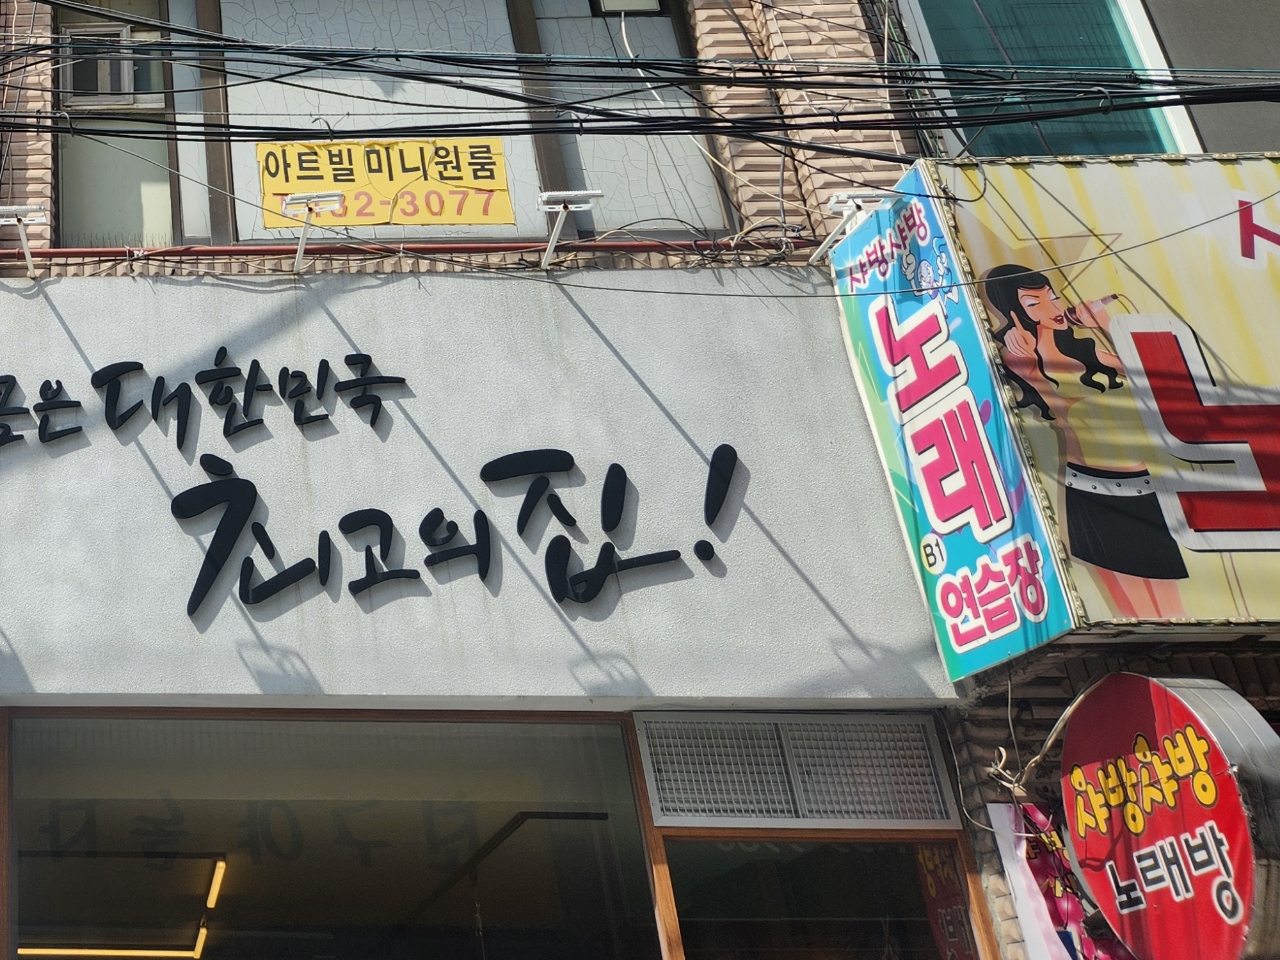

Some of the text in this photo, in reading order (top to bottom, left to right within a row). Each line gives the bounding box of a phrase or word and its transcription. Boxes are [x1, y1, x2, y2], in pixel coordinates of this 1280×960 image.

[922, 541, 943, 569] B1
[940, 544, 1045, 644] 연습장
[1105, 820, 1245, 926] 노래방
